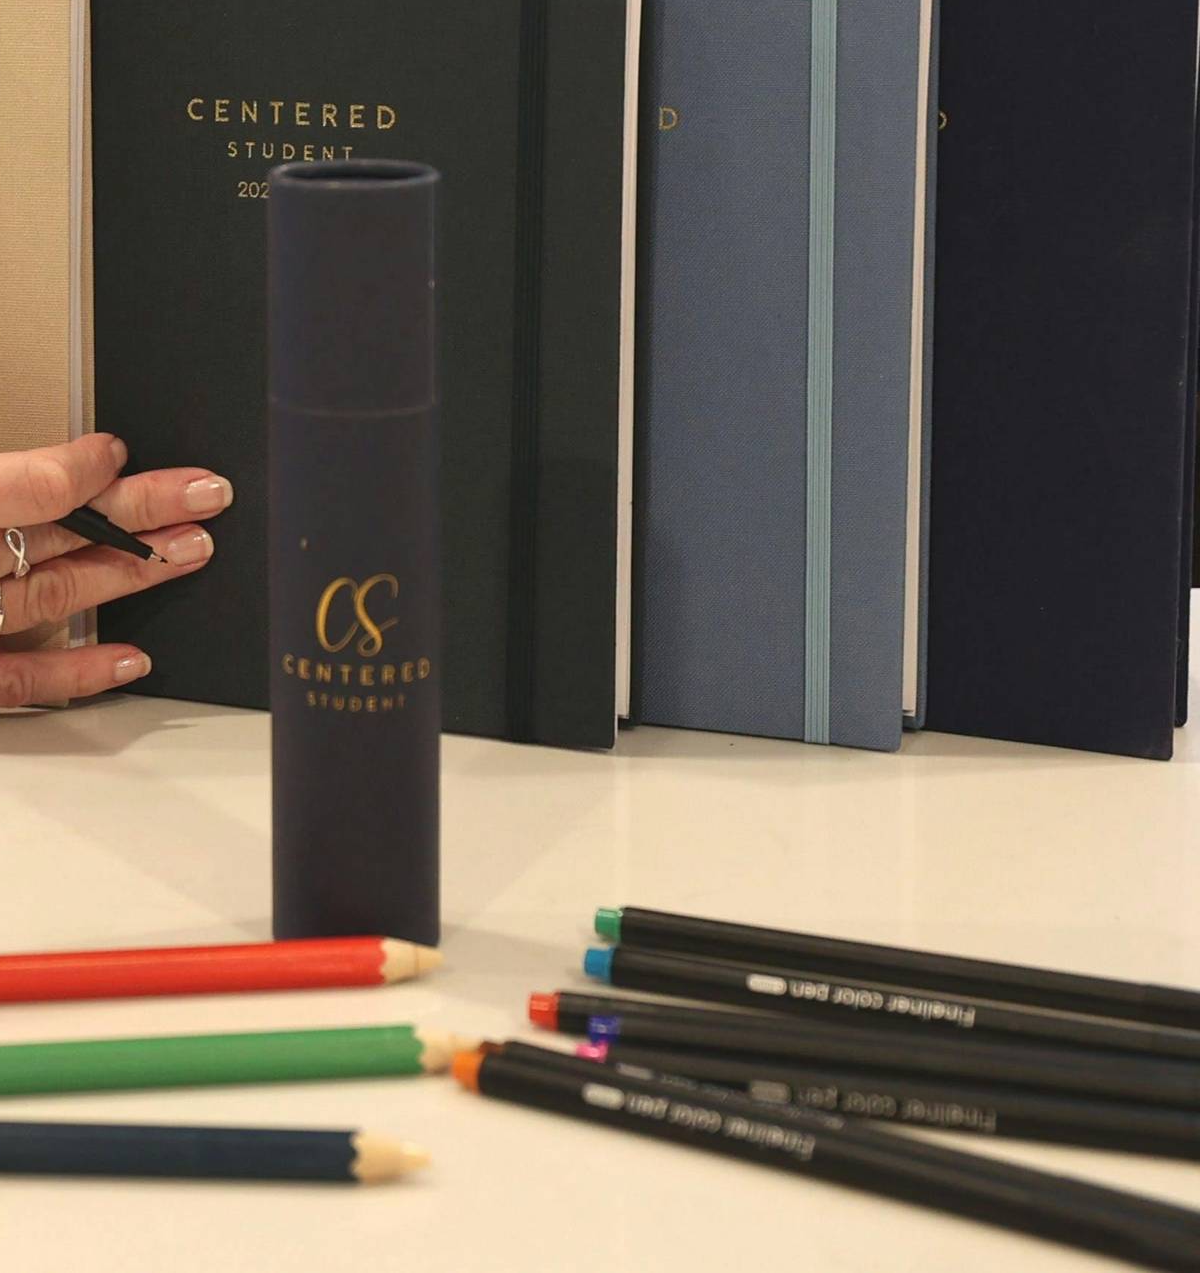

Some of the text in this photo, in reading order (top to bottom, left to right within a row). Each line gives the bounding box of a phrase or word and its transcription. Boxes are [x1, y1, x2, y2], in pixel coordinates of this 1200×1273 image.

[186, 98, 396, 130] CENTERED
[227, 141, 353, 162] STUDENT
[281, 653, 431, 687] CENTERED
[307, 690, 406, 713] STUDENT
[789, 979, 829, 1002] pen
[831, 986, 883, 1010] color
[885, 995, 976, 1028] Fineliner
[625, 1093, 669, 1120] pen
[795, 1084, 838, 1110] pen
[842, 1089, 898, 1118] color
[669, 1103, 722, 1133] color
[901, 1097, 997, 1133] Fineliner
[723, 1113, 816, 1161] Fineliner
